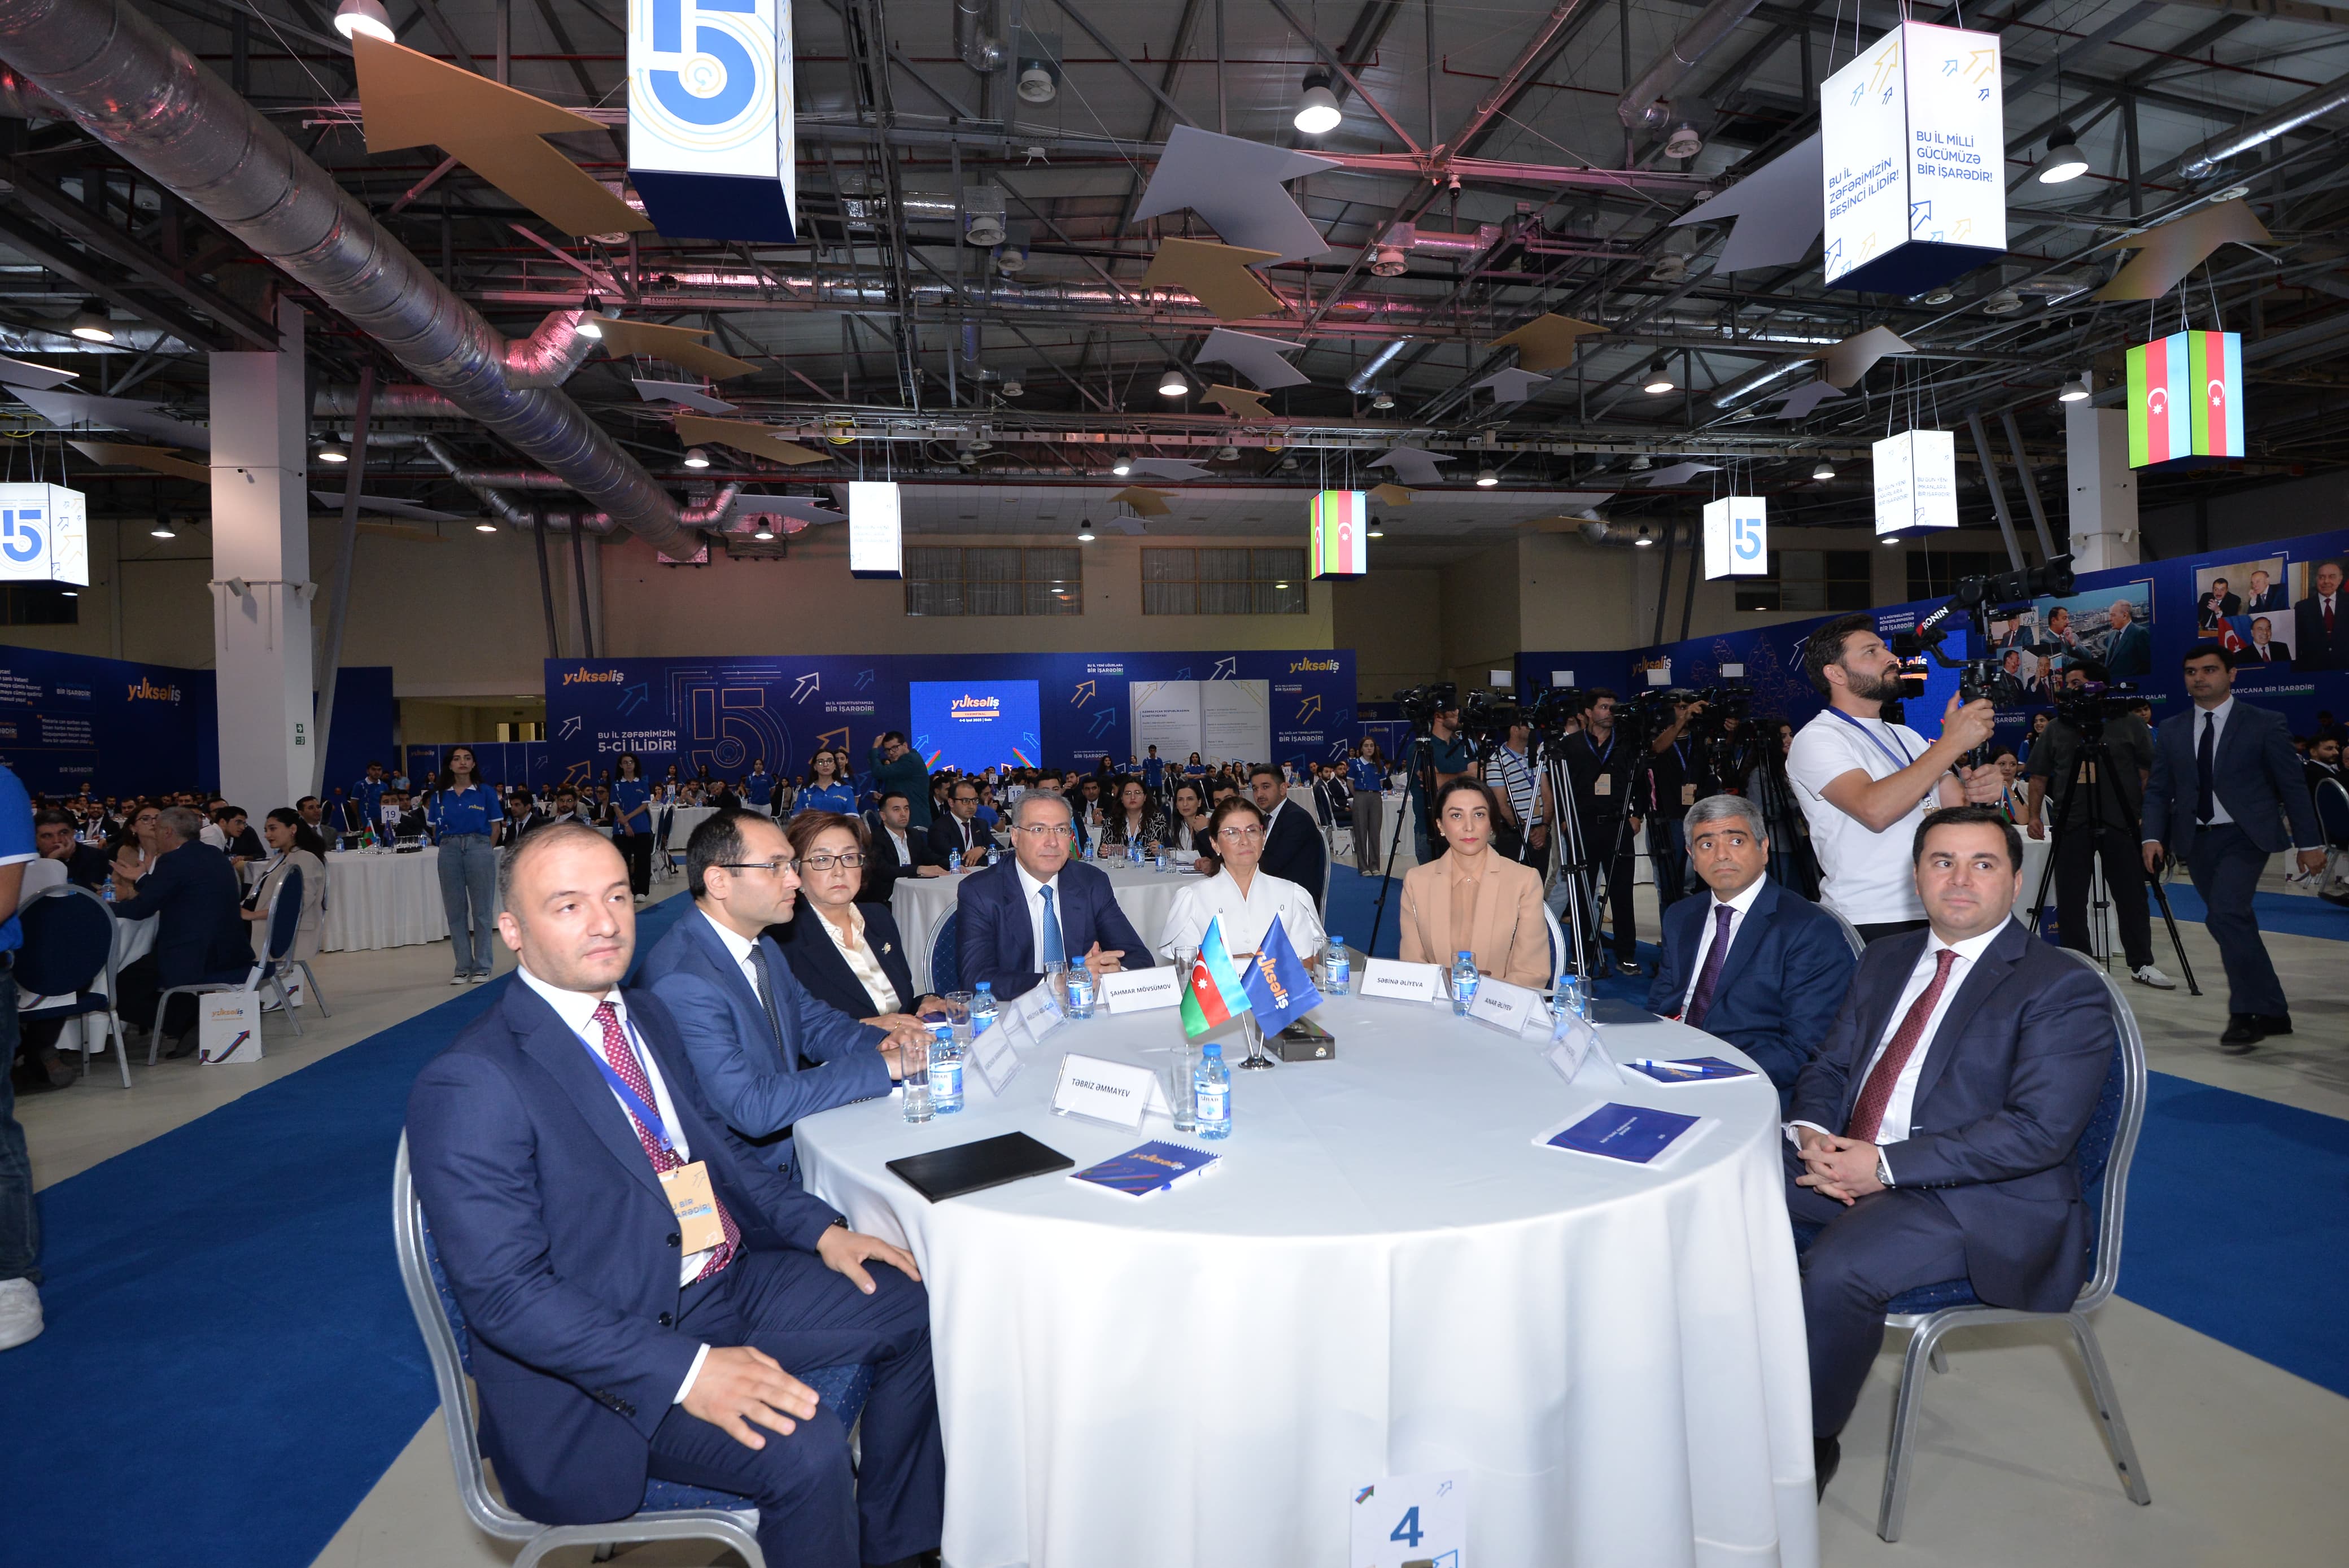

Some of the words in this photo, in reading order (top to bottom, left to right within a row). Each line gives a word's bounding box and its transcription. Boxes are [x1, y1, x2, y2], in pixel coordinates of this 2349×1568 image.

[1916, 130, 1931, 142] BU
[1935, 130, 1944, 143] İL
[1946, 132, 1975, 148] MİLLİ
[1917, 145, 1981, 164] GÜCÜMÜZƏ
[1829, 173, 1842, 189] BU
[1844, 167, 1852, 182] İL
[1830, 158, 1892, 204] ZƏFƏRİMİZİN
[1917, 163, 1936, 176] BİR
[1938, 164, 1993, 182] İŞARƏDİR!
[1830, 187, 1867, 219] BEŞİNCİ
[1868, 169, 1900, 196] İLİDİR!
[1889, 622, 1915, 631] İŞARƏDİR!
[1922, 606, 1949, 630] RONIN
[1290, 657, 1339, 673] yüksəliş
[563, 666, 624, 685] yüksəliş
[66, 688, 91, 697] İŞARƏDİR!
[2278, 683, 2315, 692] İŞARƏDİR!
[951, 694, 999, 710] yüksəliş
[1994, 715, 2025, 724] İŞARƏDİR!
[622, 729, 676, 738] ZƏFƏRİMİZİN
[598, 739, 626, 752] 5-Cİ
[631, 738, 676, 752] İLİDİR!
[1110, 988, 1136, 997] ŞAHMAR
[1137, 984, 1171, 994] MÖVSÜMOV
[1400, 980, 1424, 988] ƏLİYEVA
[1072, 1078, 1094, 1090] TƏBRİZ
[1095, 1084, 1131, 1098] ƏMMAYEV
[1390, 1506, 1424, 1548] 4
